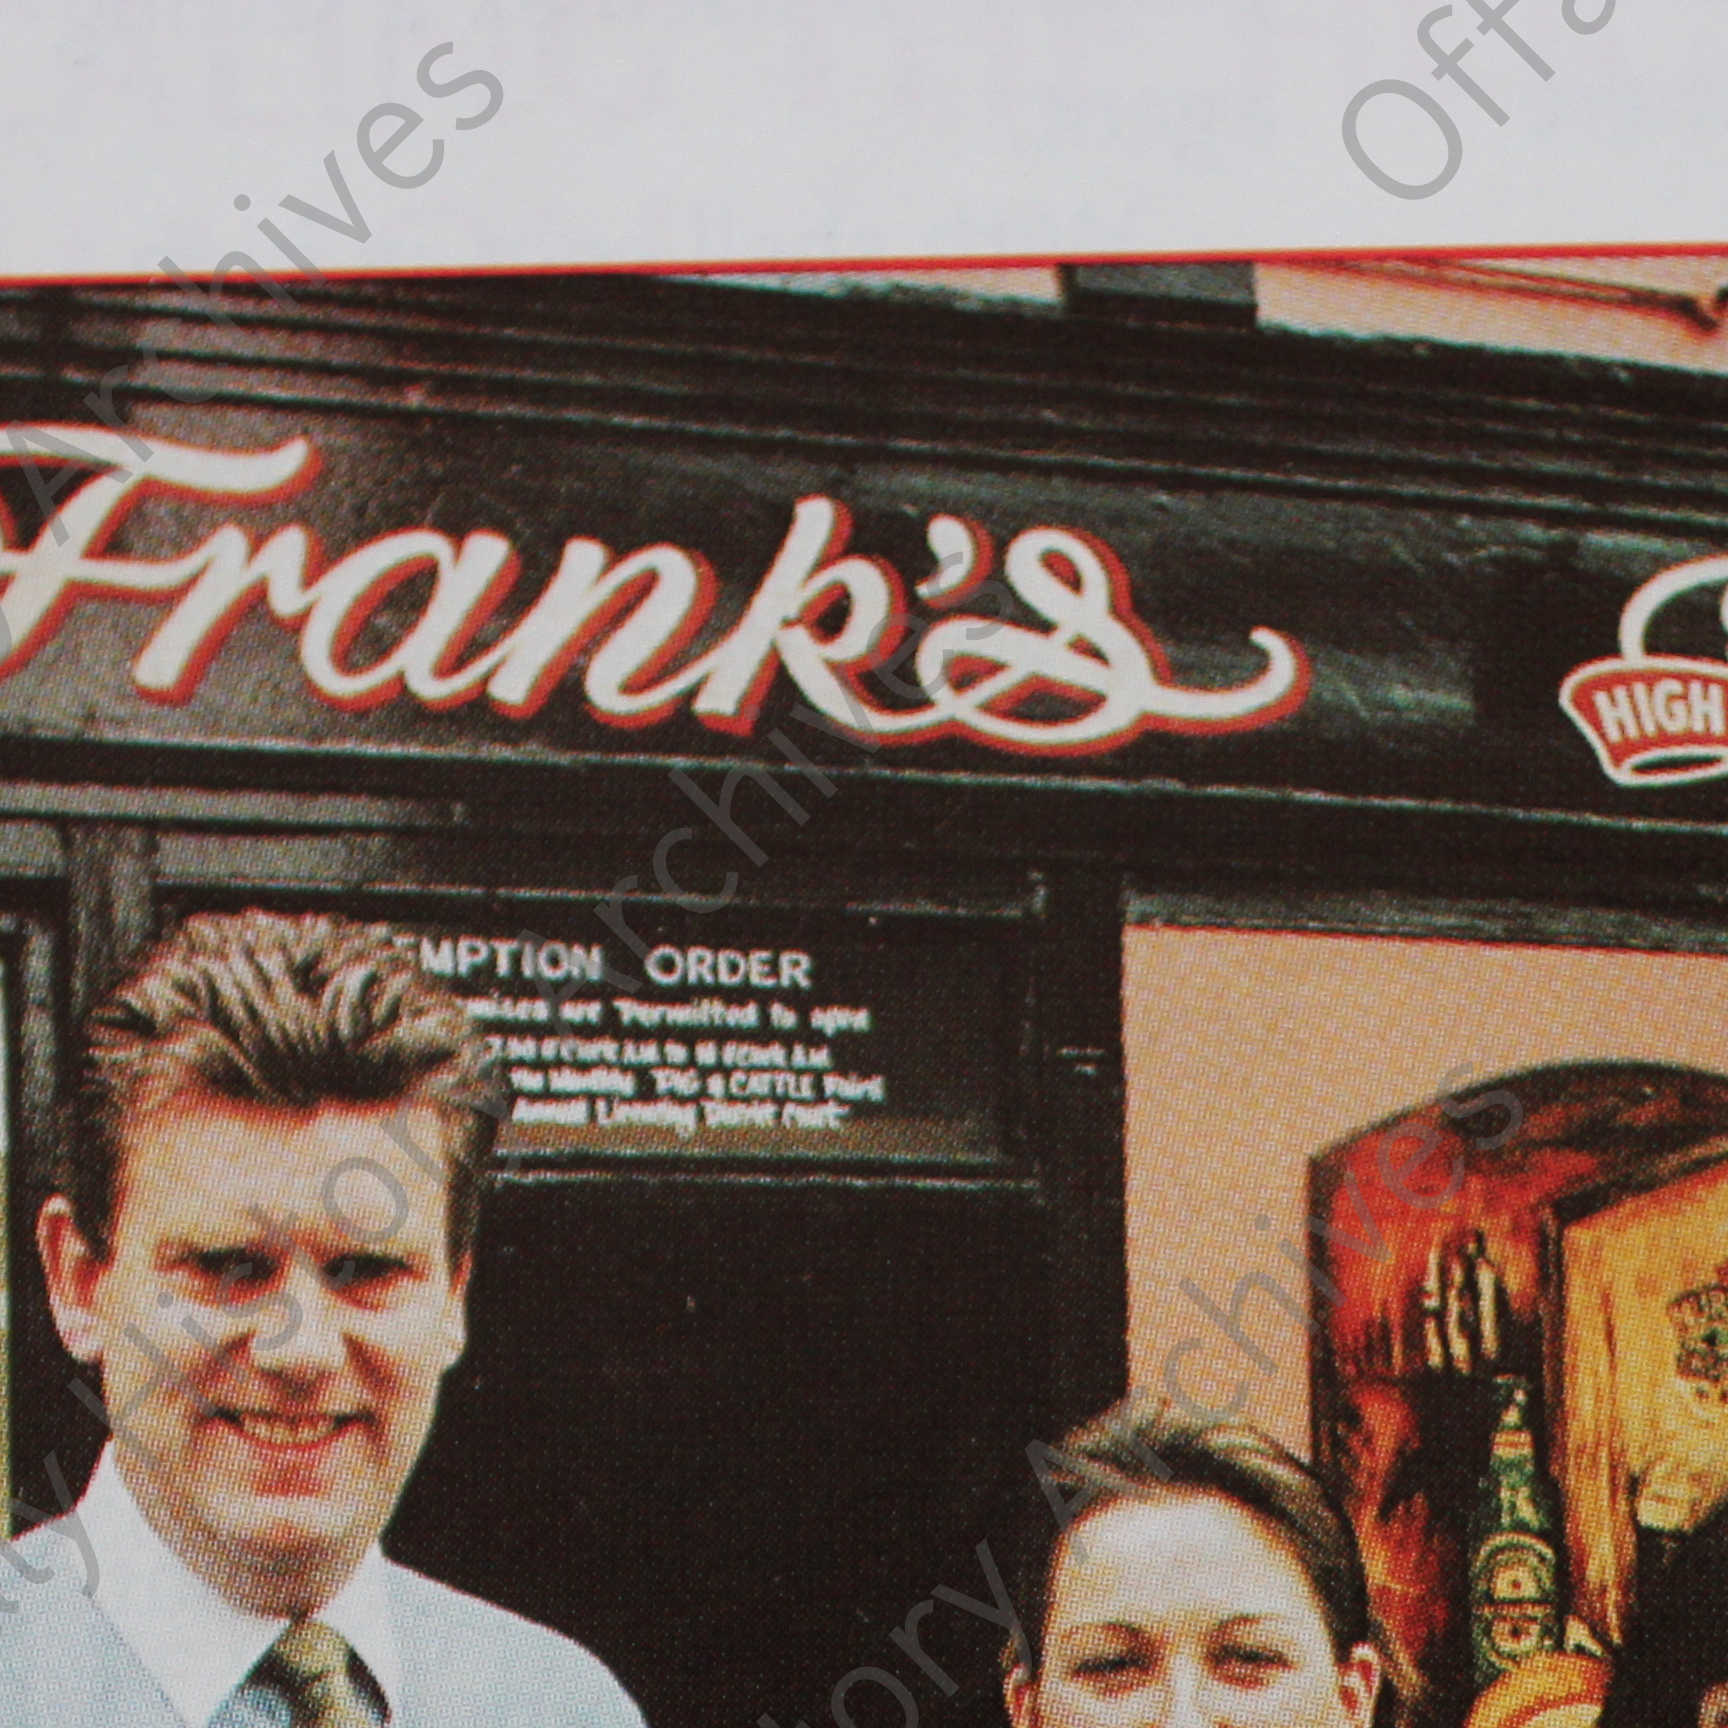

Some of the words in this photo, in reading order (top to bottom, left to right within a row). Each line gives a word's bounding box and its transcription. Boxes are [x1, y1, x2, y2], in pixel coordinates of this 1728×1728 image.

[1593, 679, 1726, 743] HIGH
[412, 935, 603, 984] MPTION
[645, 945, 813, 988] ORDER
